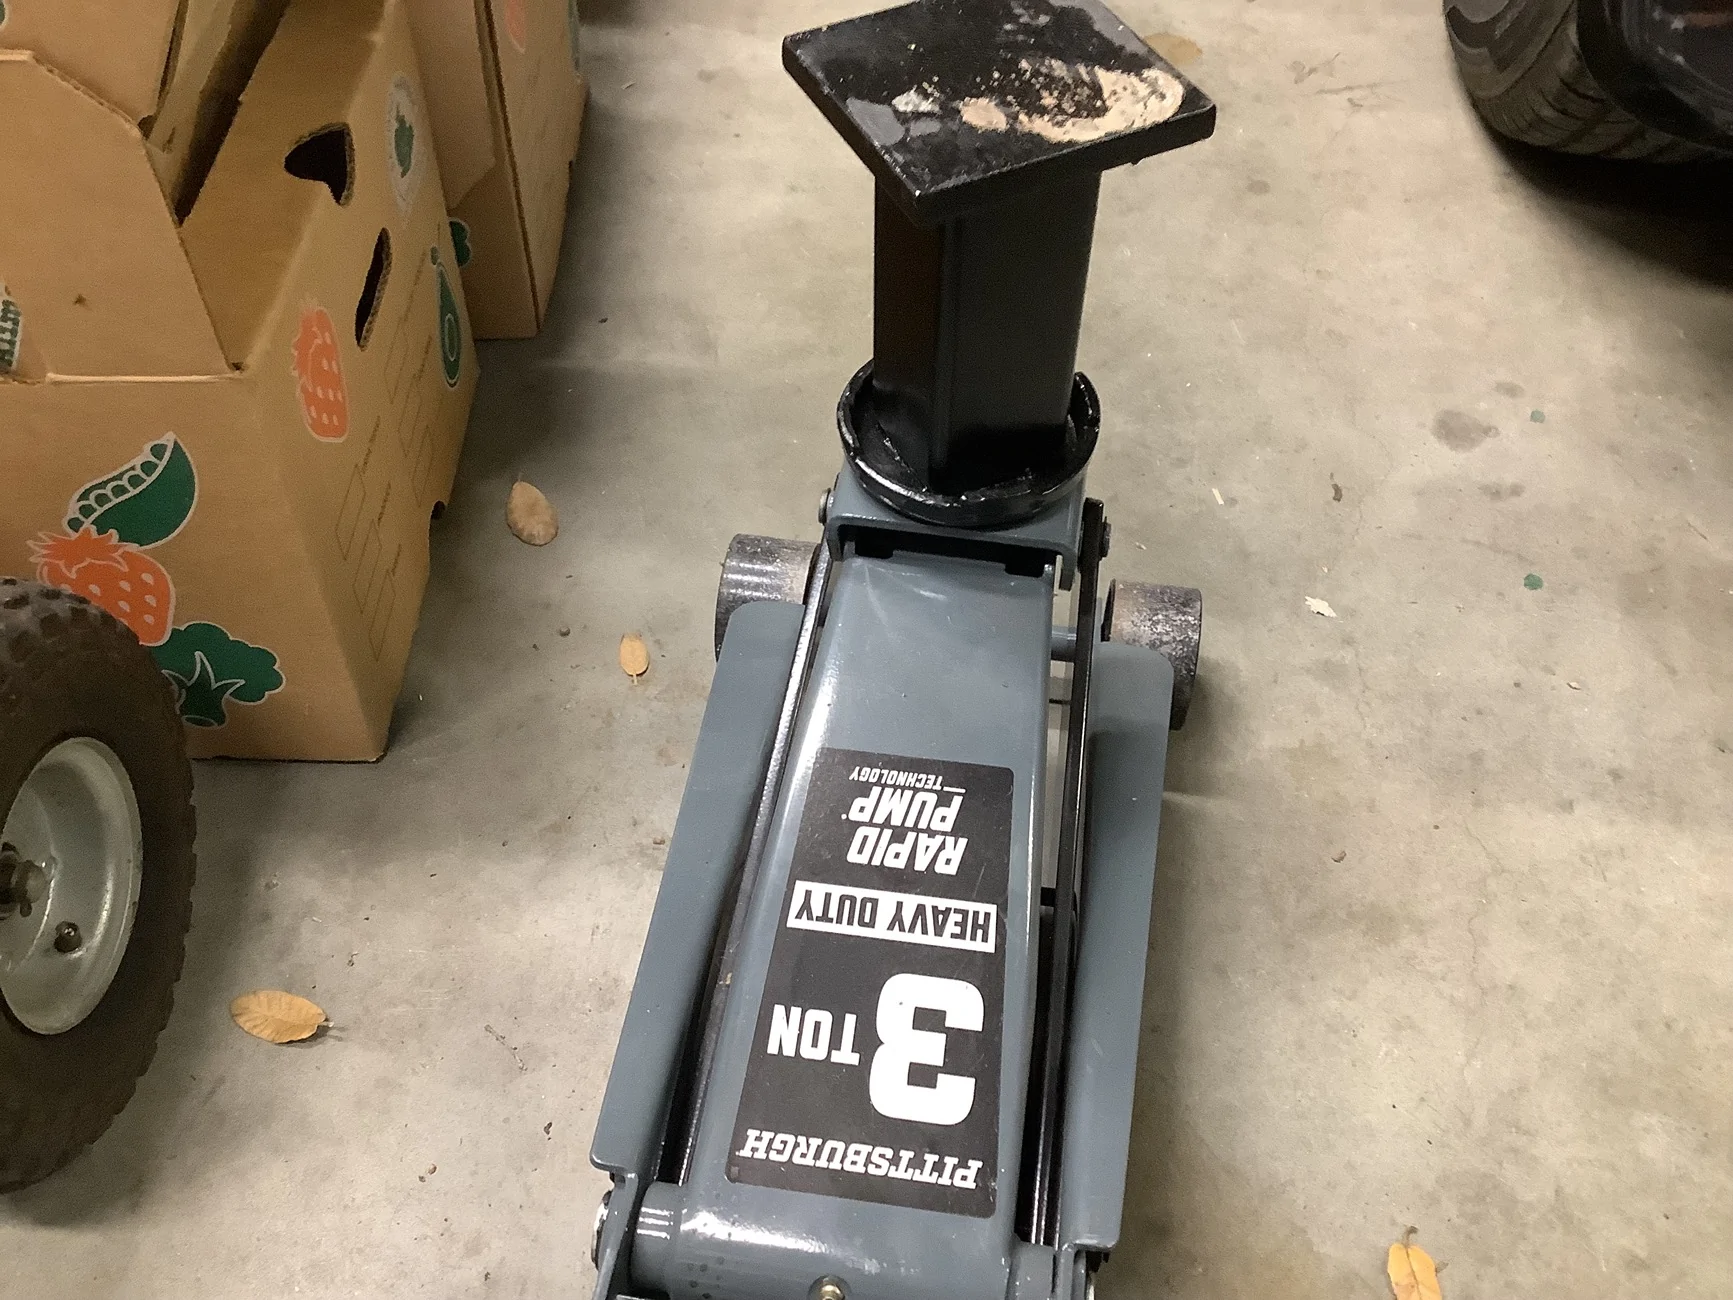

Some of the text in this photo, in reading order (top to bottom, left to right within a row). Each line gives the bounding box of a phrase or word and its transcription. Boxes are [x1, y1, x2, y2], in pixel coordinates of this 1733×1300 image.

[849, 766, 943, 791] TECHNOLOGY
[848, 786, 964, 831] PUMP
[847, 825, 968, 875] RAPID
[795, 889, 991, 943] HEAVY DUTY
[767, 973, 984, 1125] 3 TON
[738, 1129, 983, 1189] PITTSBURGH
